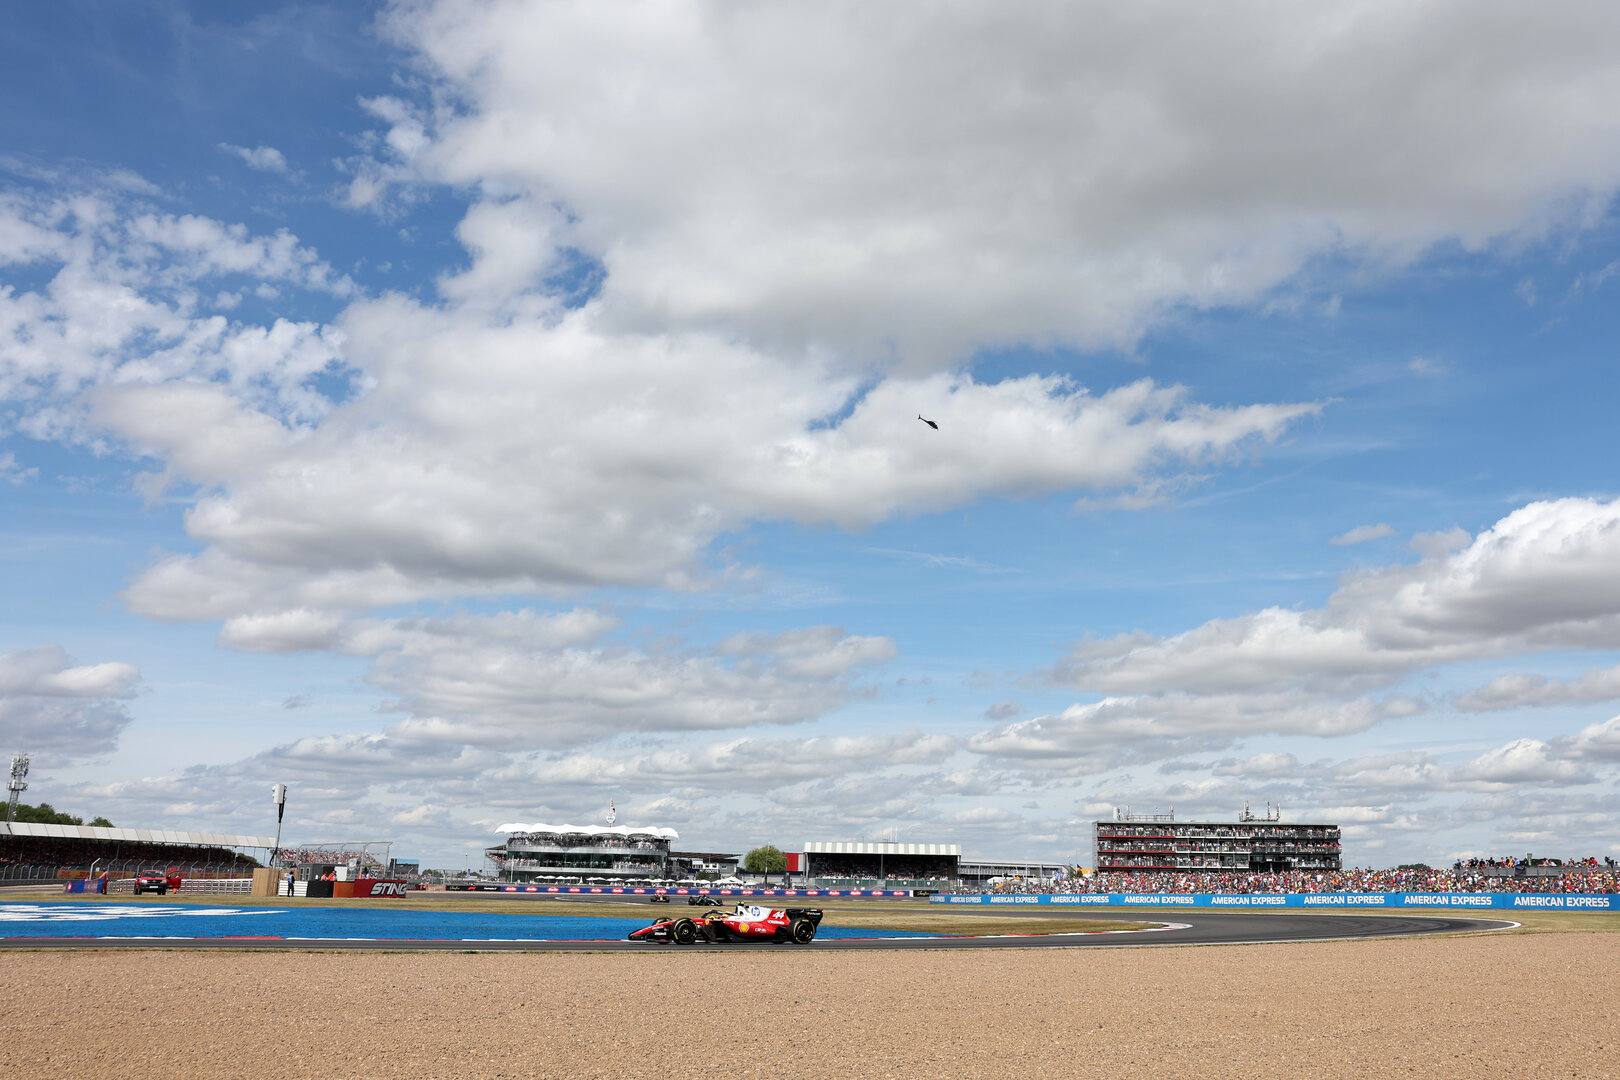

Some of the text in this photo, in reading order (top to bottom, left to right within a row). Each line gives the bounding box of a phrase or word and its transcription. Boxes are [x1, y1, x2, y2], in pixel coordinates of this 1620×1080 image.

[1161, 896, 1194, 904] EXPRESS
[1211, 896, 1286, 905] AMERICAN EXPRESS
[1304, 896, 1386, 905] AMERICAN EXPRESS
[1404, 896, 1493, 906] AMERICAN EXPRESS
[1514, 897, 1610, 908] AMERICAN EXPRESS
[773, 911, 785, 919] 44
